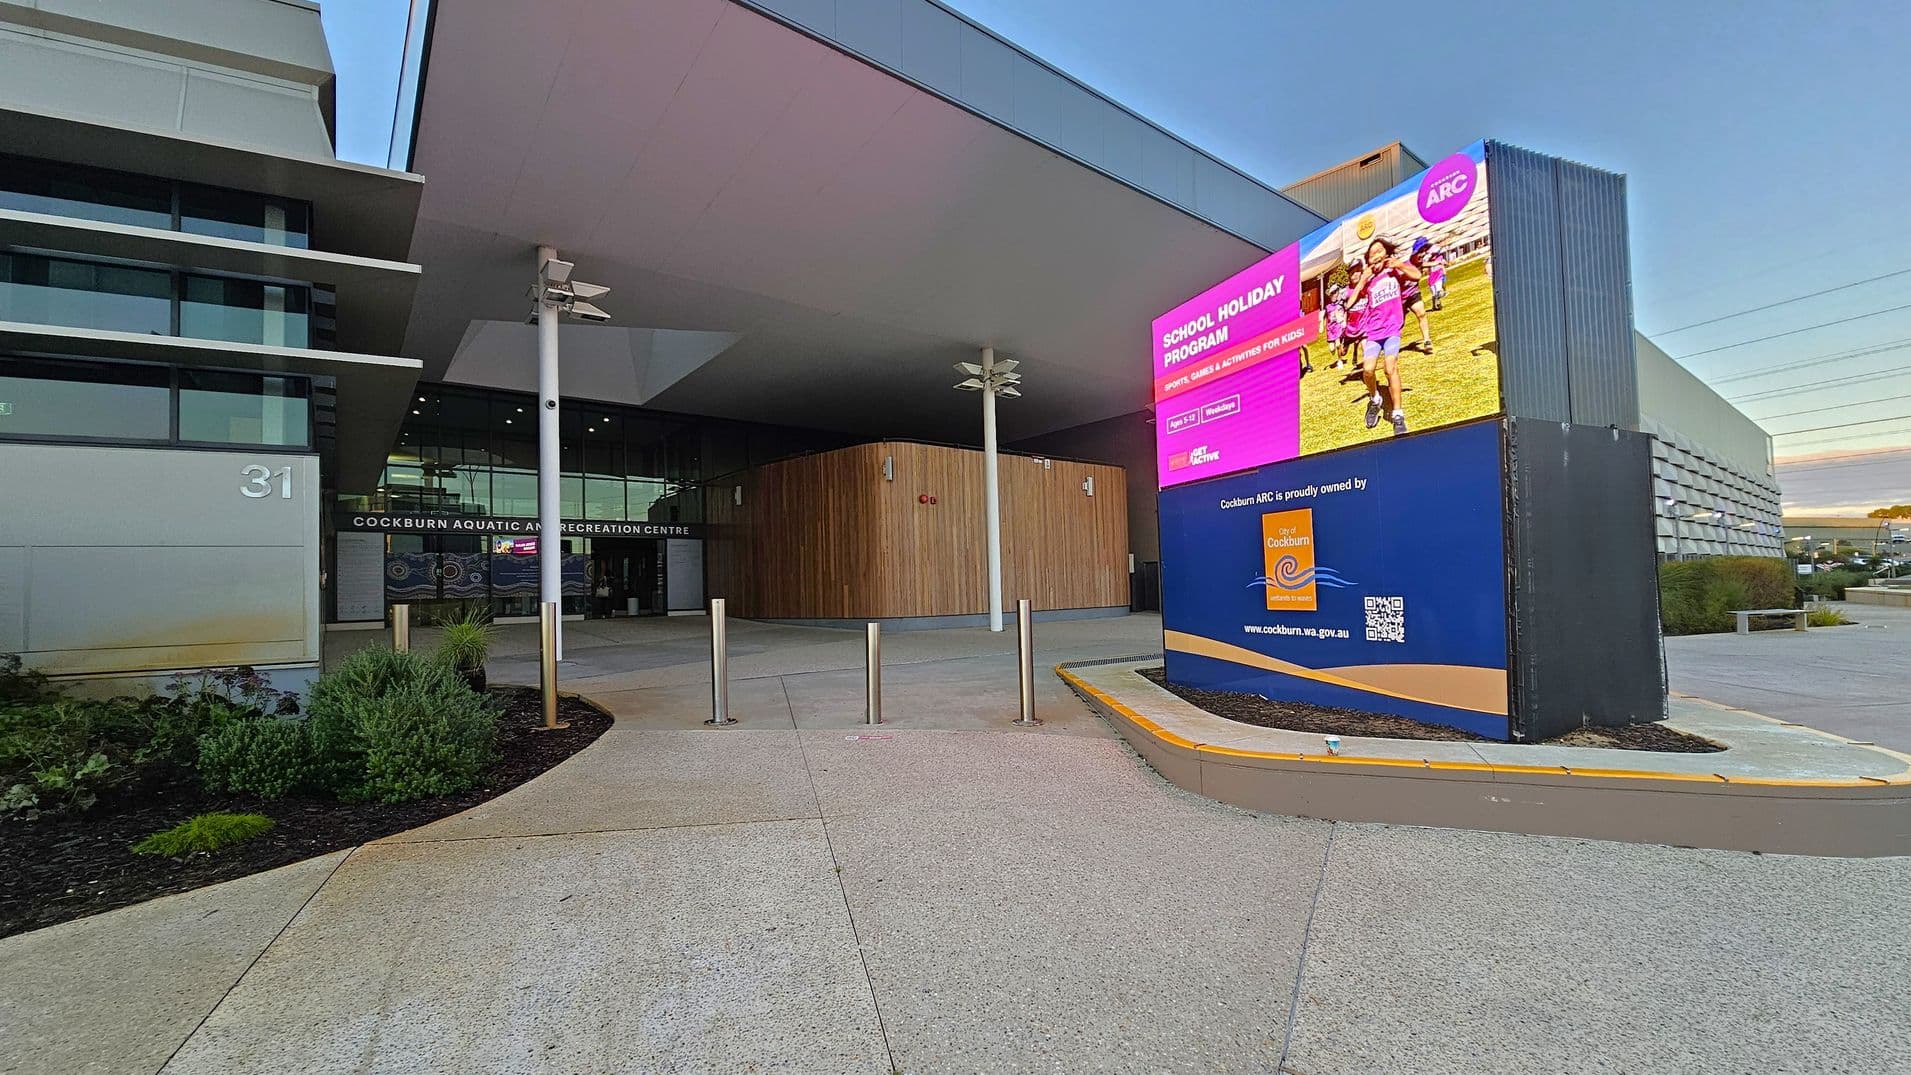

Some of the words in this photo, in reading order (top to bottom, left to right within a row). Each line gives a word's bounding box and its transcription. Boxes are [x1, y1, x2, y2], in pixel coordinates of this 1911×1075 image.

[1425, 174, 1468, 209] ARC
[1163, 316, 1214, 348] SCHOOL
[1217, 275, 1285, 323] HOLIDAY
[1164, 326, 1229, 368] PROGRAM
[1190, 365, 1214, 381] GAMES
[1215, 362, 1221, 373] &
[1221, 347, 1262, 369] ACTIVITIES
[1263, 339, 1280, 353] FOR
[1281, 327, 1305, 344] KIDS!
[1205, 401, 1236, 416] Weekdays
[1169, 419, 1183, 429] Ages
[1191, 451, 1220, 465] ACTIVE
[1192, 445, 1208, 457] GET
[239, 464, 292, 499] 31
[1220, 496, 1255, 510] Cockburn
[1256, 491, 1274, 504] ARC
[1275, 489, 1283, 501] is
[1284, 484, 1319, 502] proudly
[1320, 479, 1352, 494] owned
[1354, 477, 1368, 490] by
[353, 516, 448, 530] COCKBURN
[453, 519, 521, 532] AQUATIC
[525, 522, 542, 532] AN
[560, 523, 641, 535] RECREATION
[644, 526, 690, 535] CENTRE
[1278, 527, 1290, 535] City
[1290, 526, 1297, 534] of
[1267, 534, 1310, 549] Cockburn
[1244, 623, 1350, 639] www.cockburn.wa.gov.au
